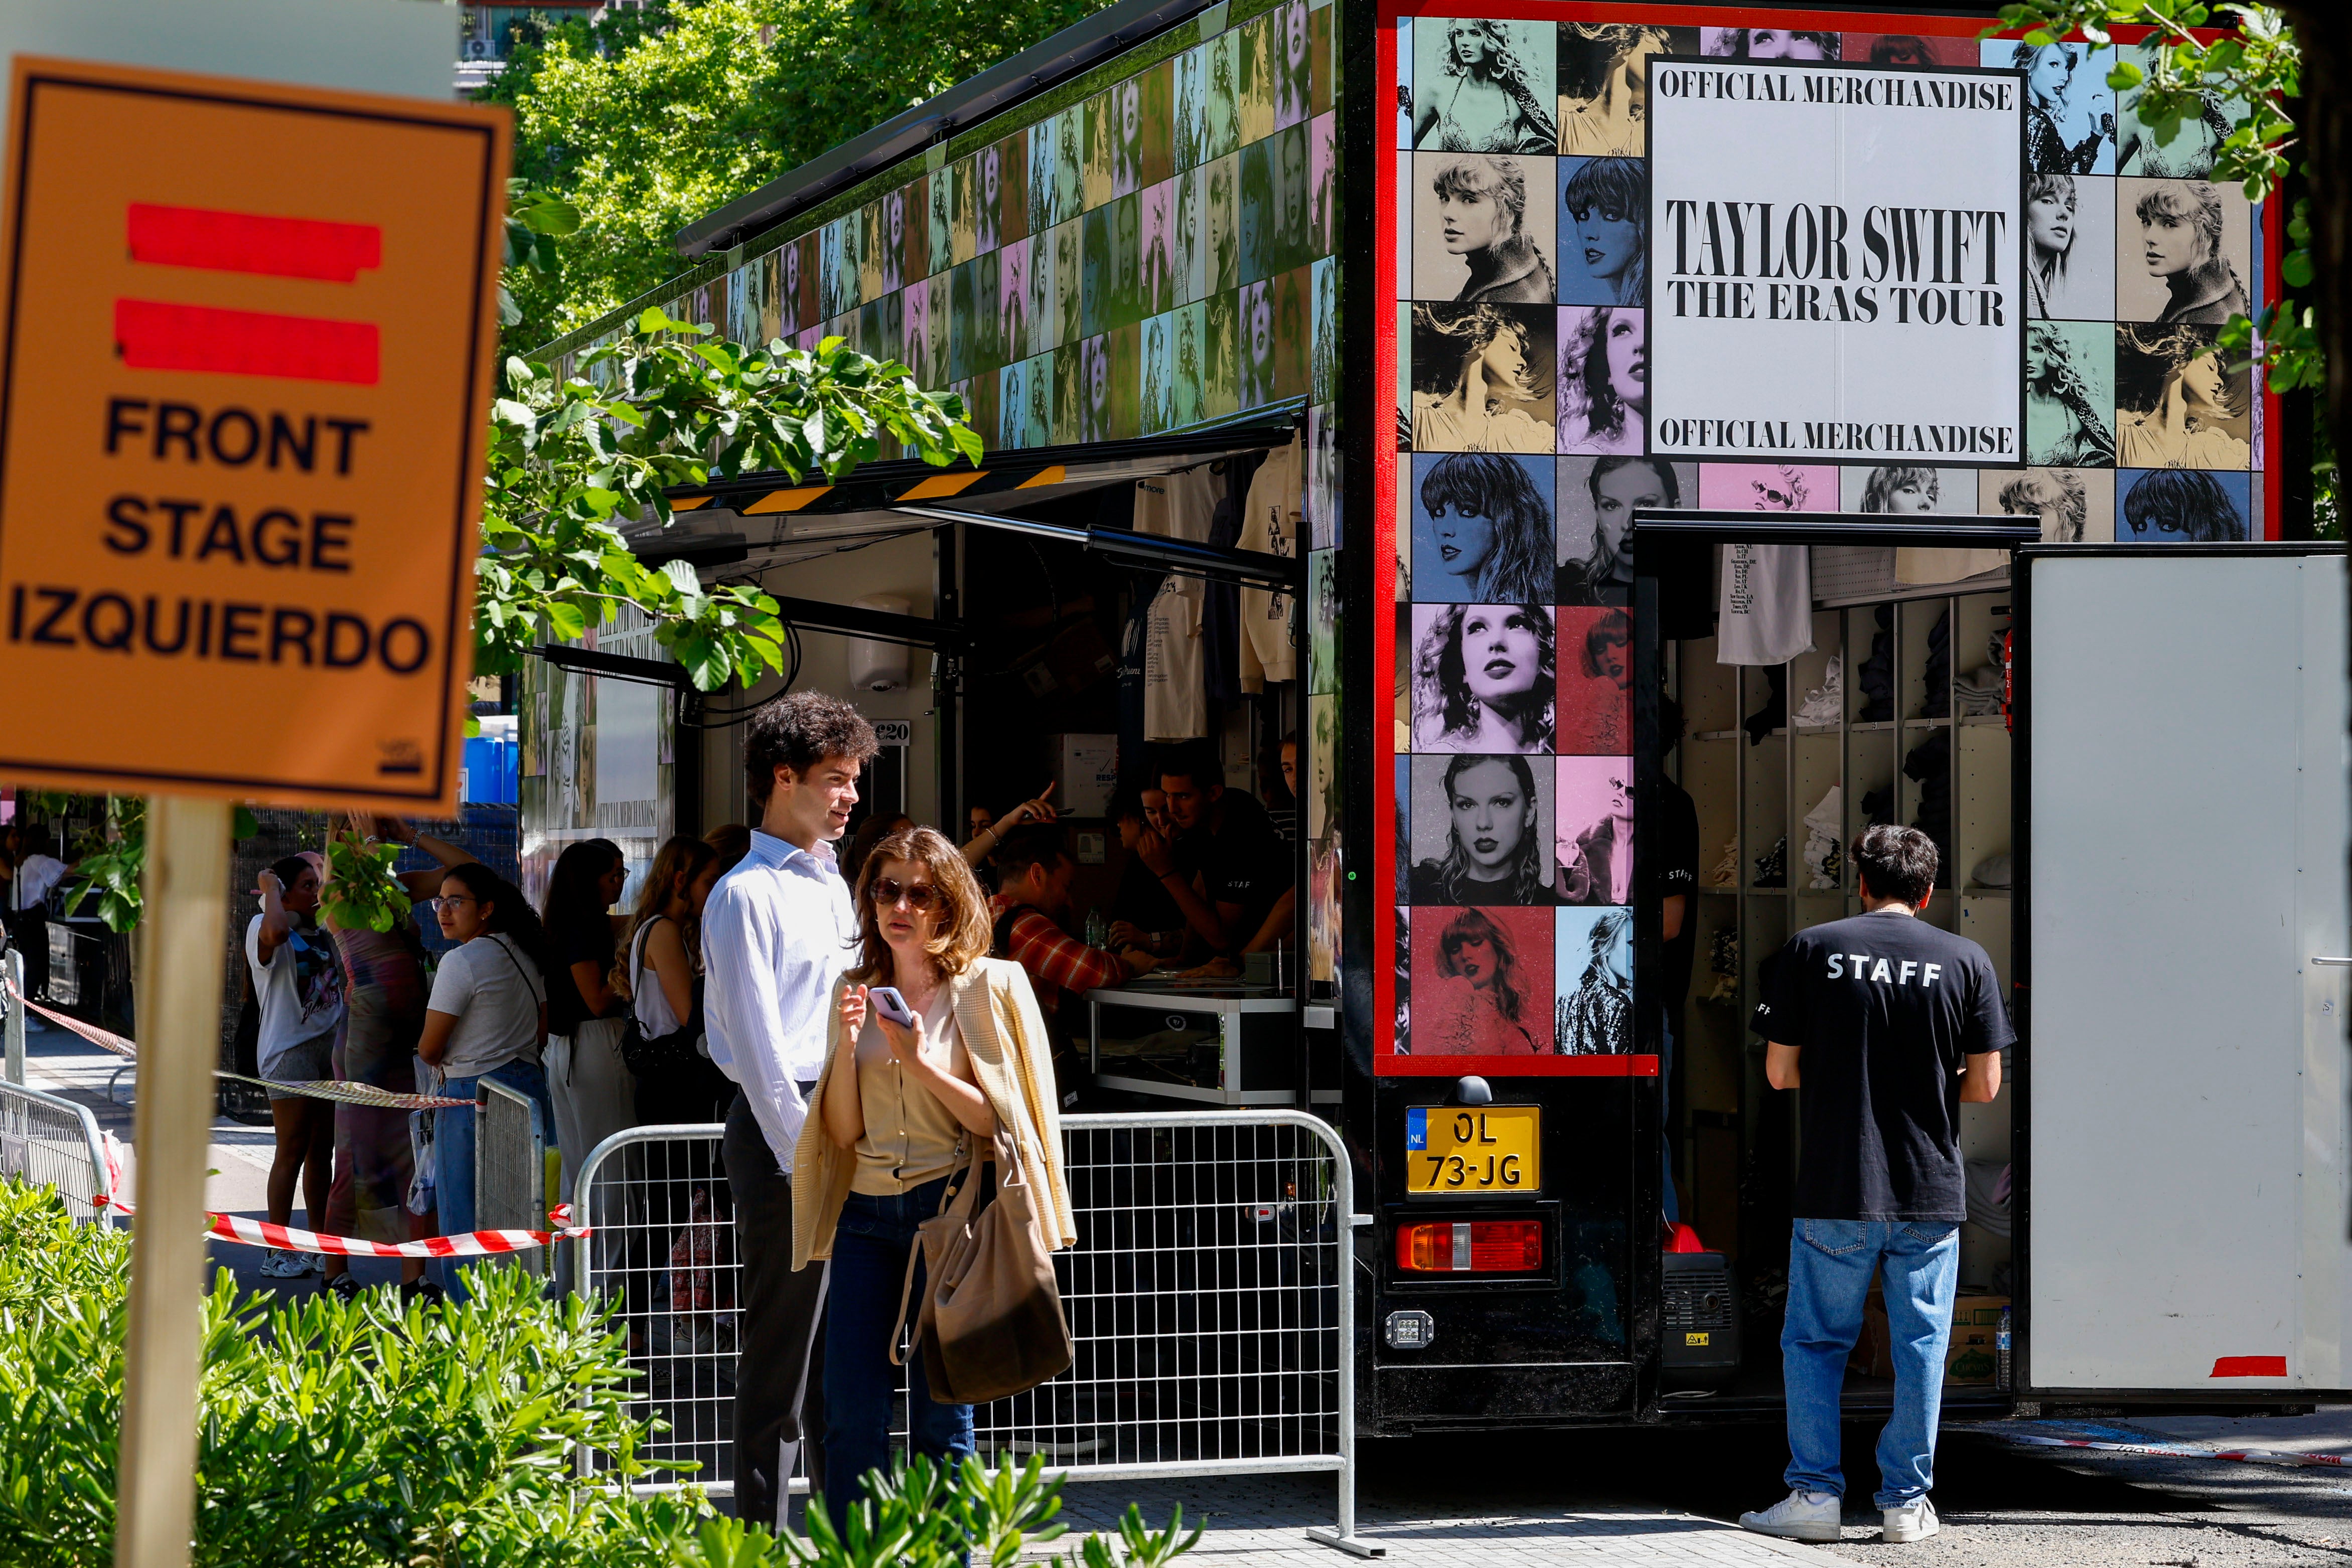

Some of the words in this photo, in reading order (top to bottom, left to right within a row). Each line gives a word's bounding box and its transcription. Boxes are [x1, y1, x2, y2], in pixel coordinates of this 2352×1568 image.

[1660, 69, 1795, 102] OFFICIAL
[1802, 75, 2013, 111] MERCHANDISE
[1666, 200, 1851, 281] TAYLOR
[1863, 206, 2006, 285] SWIFT
[1667, 281, 1755, 319] THE
[1766, 283, 1879, 323] ERAS
[1890, 287, 2006, 327] TOUR
[103, 396, 371, 476] FRONT
[1660, 418, 1795, 449] OFFICIAL
[1802, 421, 2013, 454] MERCHANDISE
[103, 493, 356, 573] STAGE
[8, 585, 430, 675] IZQUIERDO
[876, 724, 909, 740] €20
[597, 803, 619, 829] OFFICIAL
[620, 800, 657, 828] MERCHANDISE
[1827, 953, 1942, 988] STAFF
[1411, 1134, 1424, 1144] NL
[1454, 1113, 1498, 1143] OL
[1426, 1154, 1522, 1187] 73-JG
